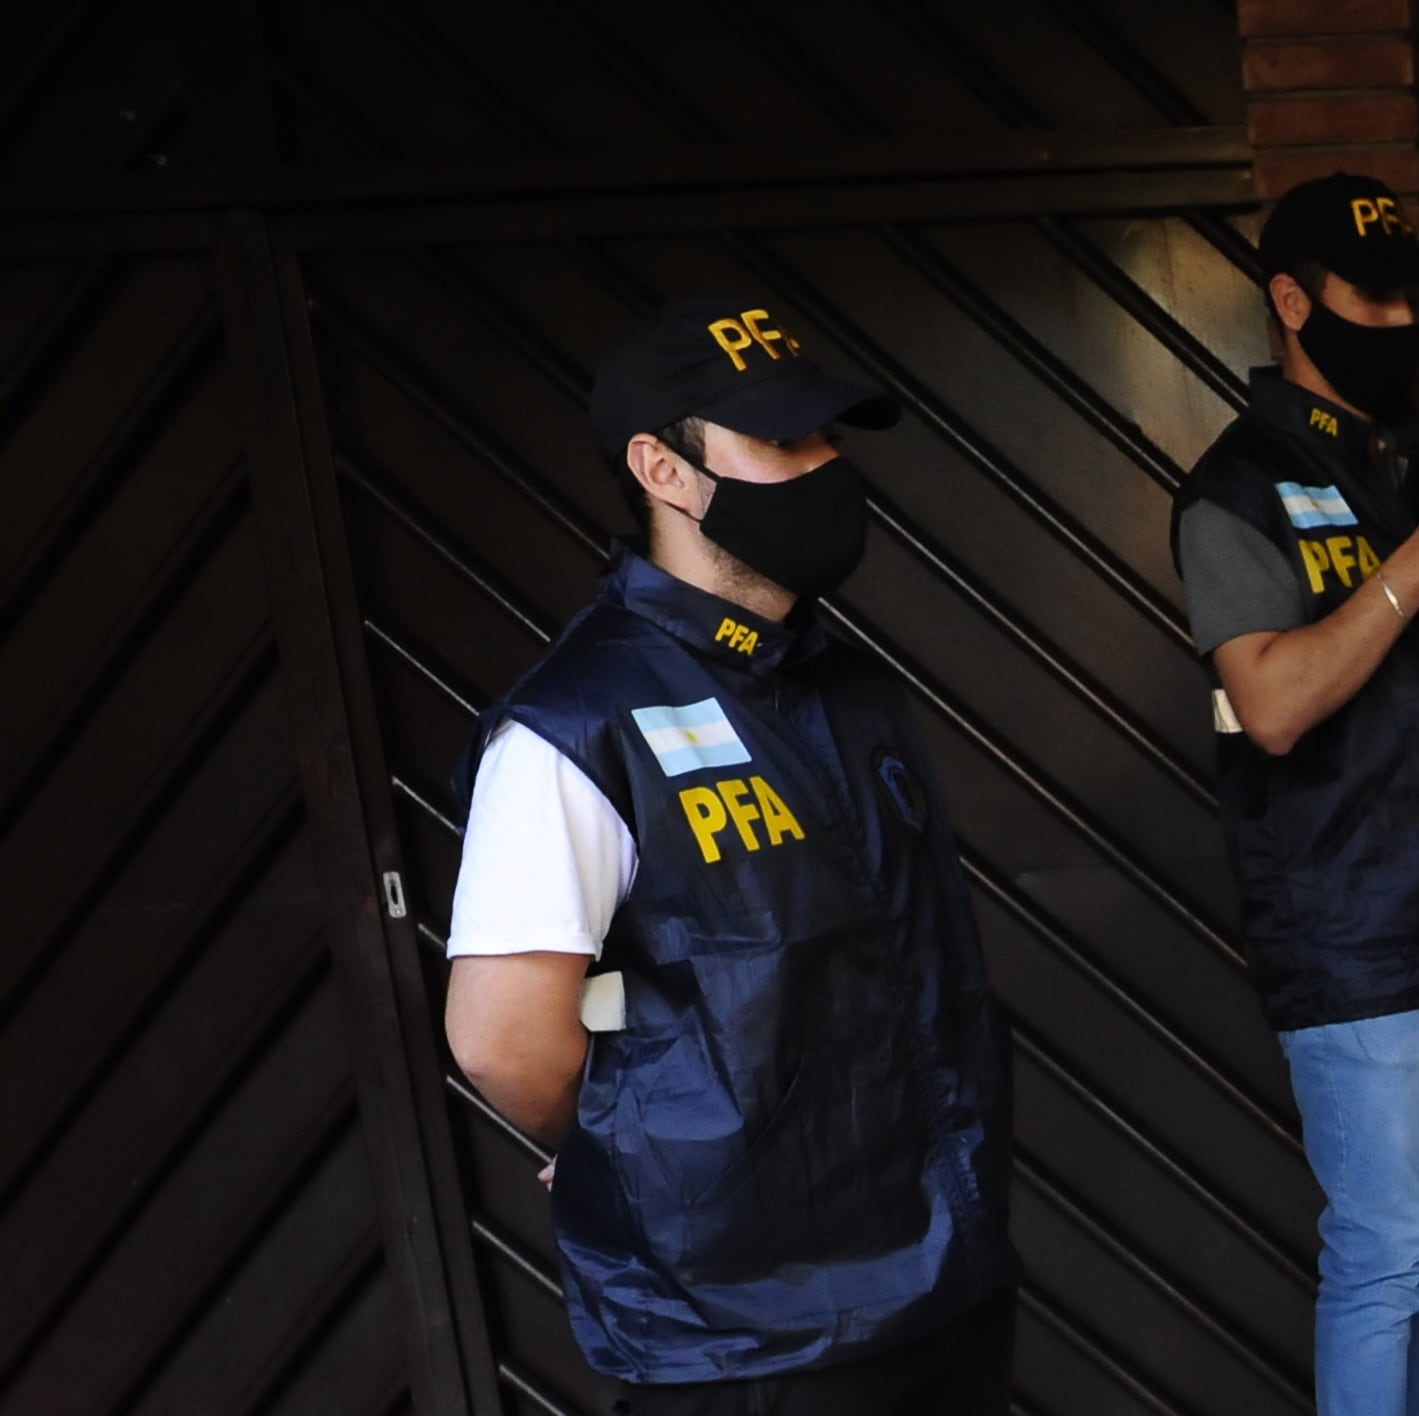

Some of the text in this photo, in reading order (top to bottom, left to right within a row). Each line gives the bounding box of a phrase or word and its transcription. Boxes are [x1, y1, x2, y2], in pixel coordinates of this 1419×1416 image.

[1349, 196, 1414, 238] PF
[1309, 407, 1339, 438] PFA
[1298, 535, 1383, 595] PFA
[715, 618, 760, 657] PFA
[679, 776, 806, 864] PFA
